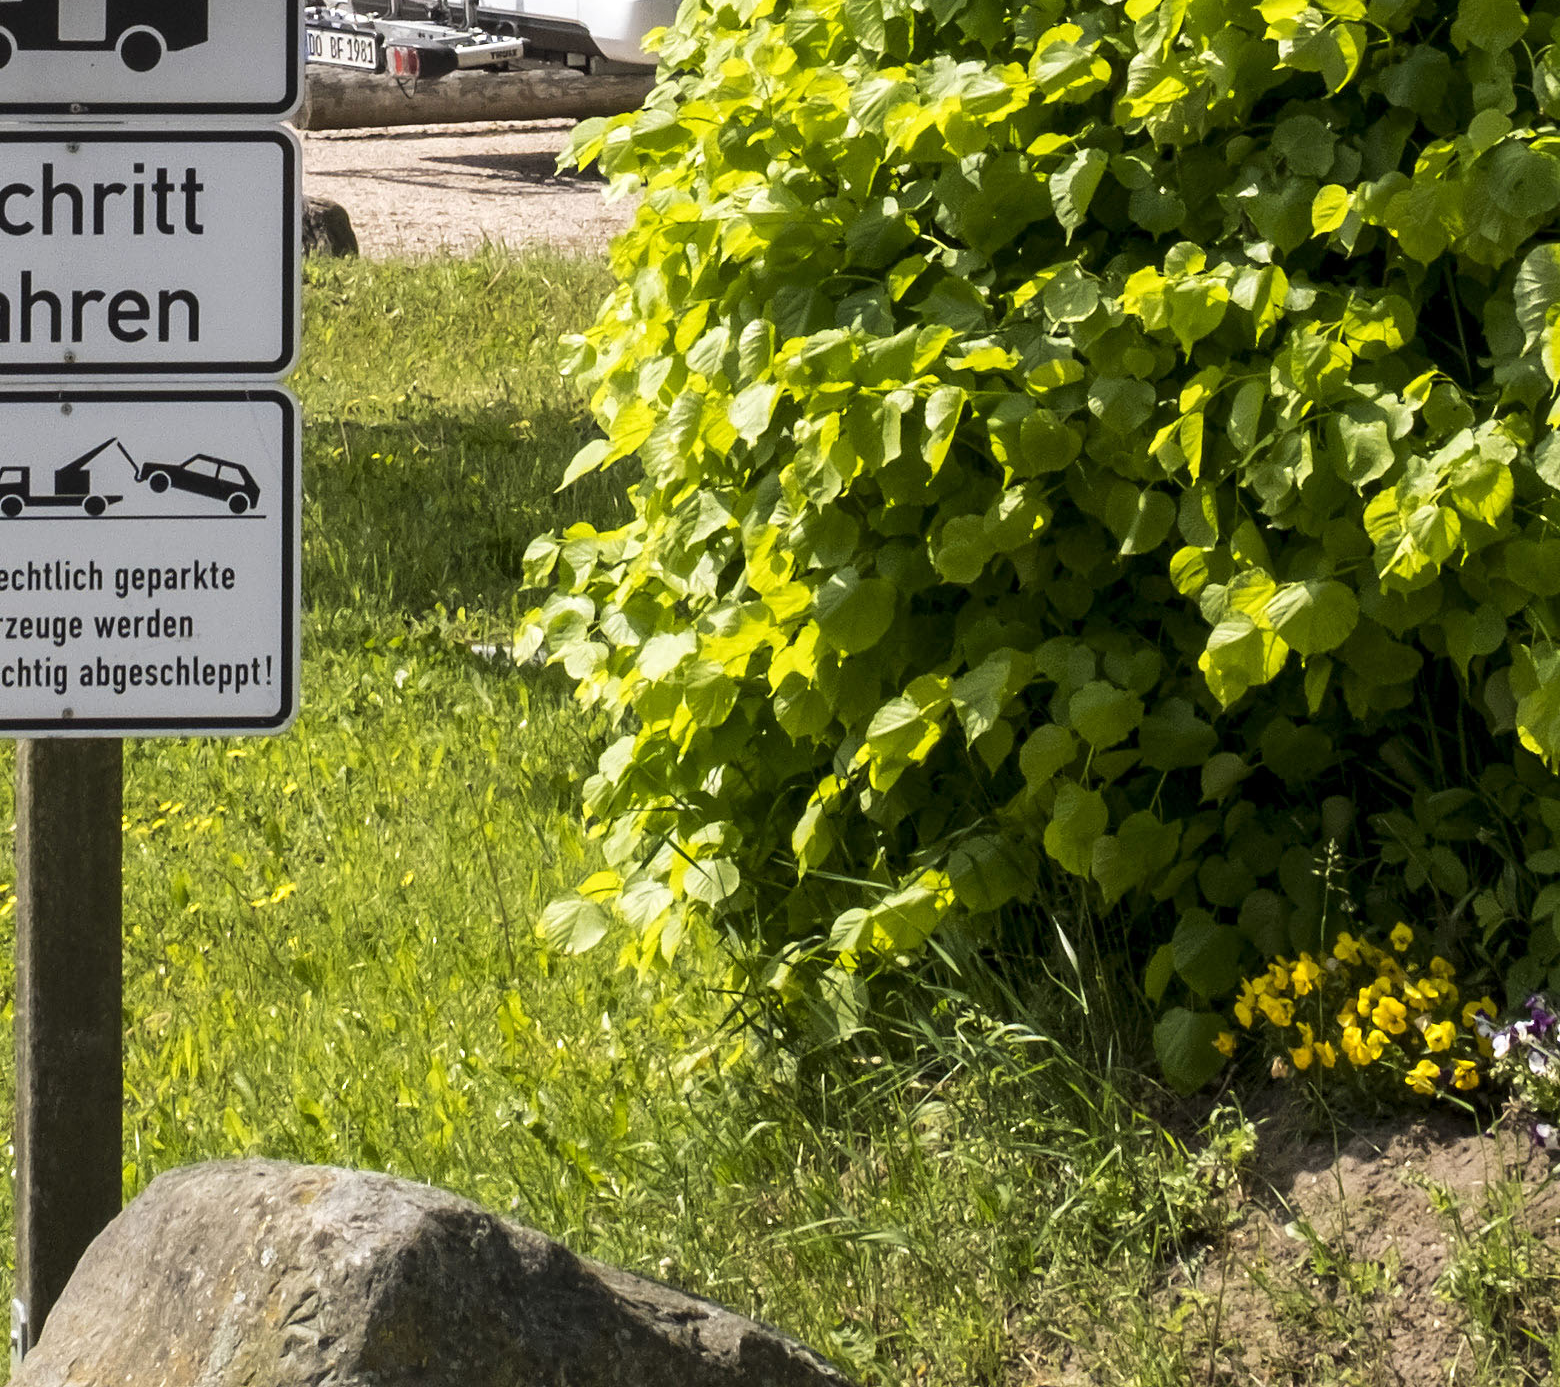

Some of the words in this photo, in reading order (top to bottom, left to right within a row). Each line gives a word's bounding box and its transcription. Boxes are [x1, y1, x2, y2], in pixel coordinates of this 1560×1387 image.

[308, 33, 323, 57] DO
[347, 38, 374, 63] 1981
[115, 559, 236, 598] geparkte
[94, 608, 194, 638] werden
[80, 655, 273, 694] abgeschleppt!
